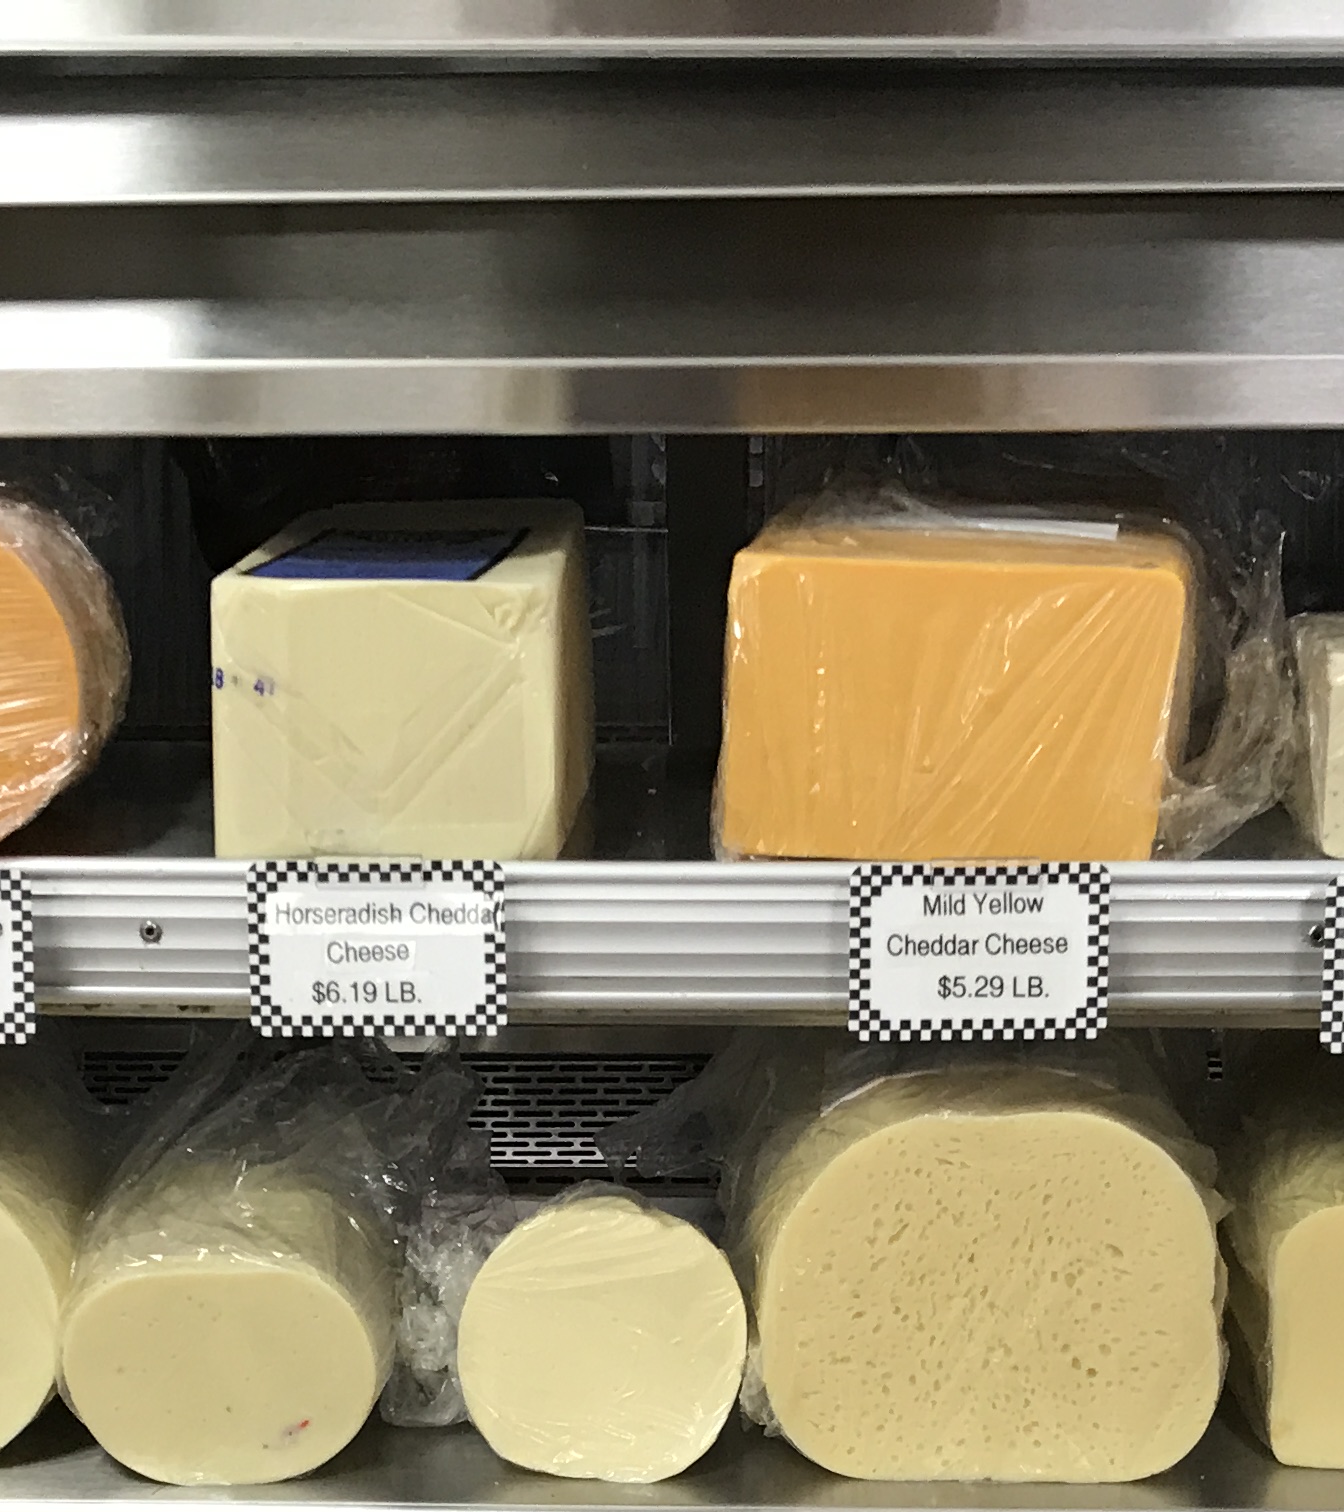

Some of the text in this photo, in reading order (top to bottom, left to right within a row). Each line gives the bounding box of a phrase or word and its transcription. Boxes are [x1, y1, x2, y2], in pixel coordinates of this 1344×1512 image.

[275, 902, 494, 926] Horseradish Chedda
[923, 891, 1044, 917] Mild Yellow
[326, 941, 410, 964] Cheese
[887, 933, 1069, 957] Cheddar Cheese
[312, 980, 422, 1005] $6.19 LB.
[937, 975, 1050, 1000] $5.29 LB.
